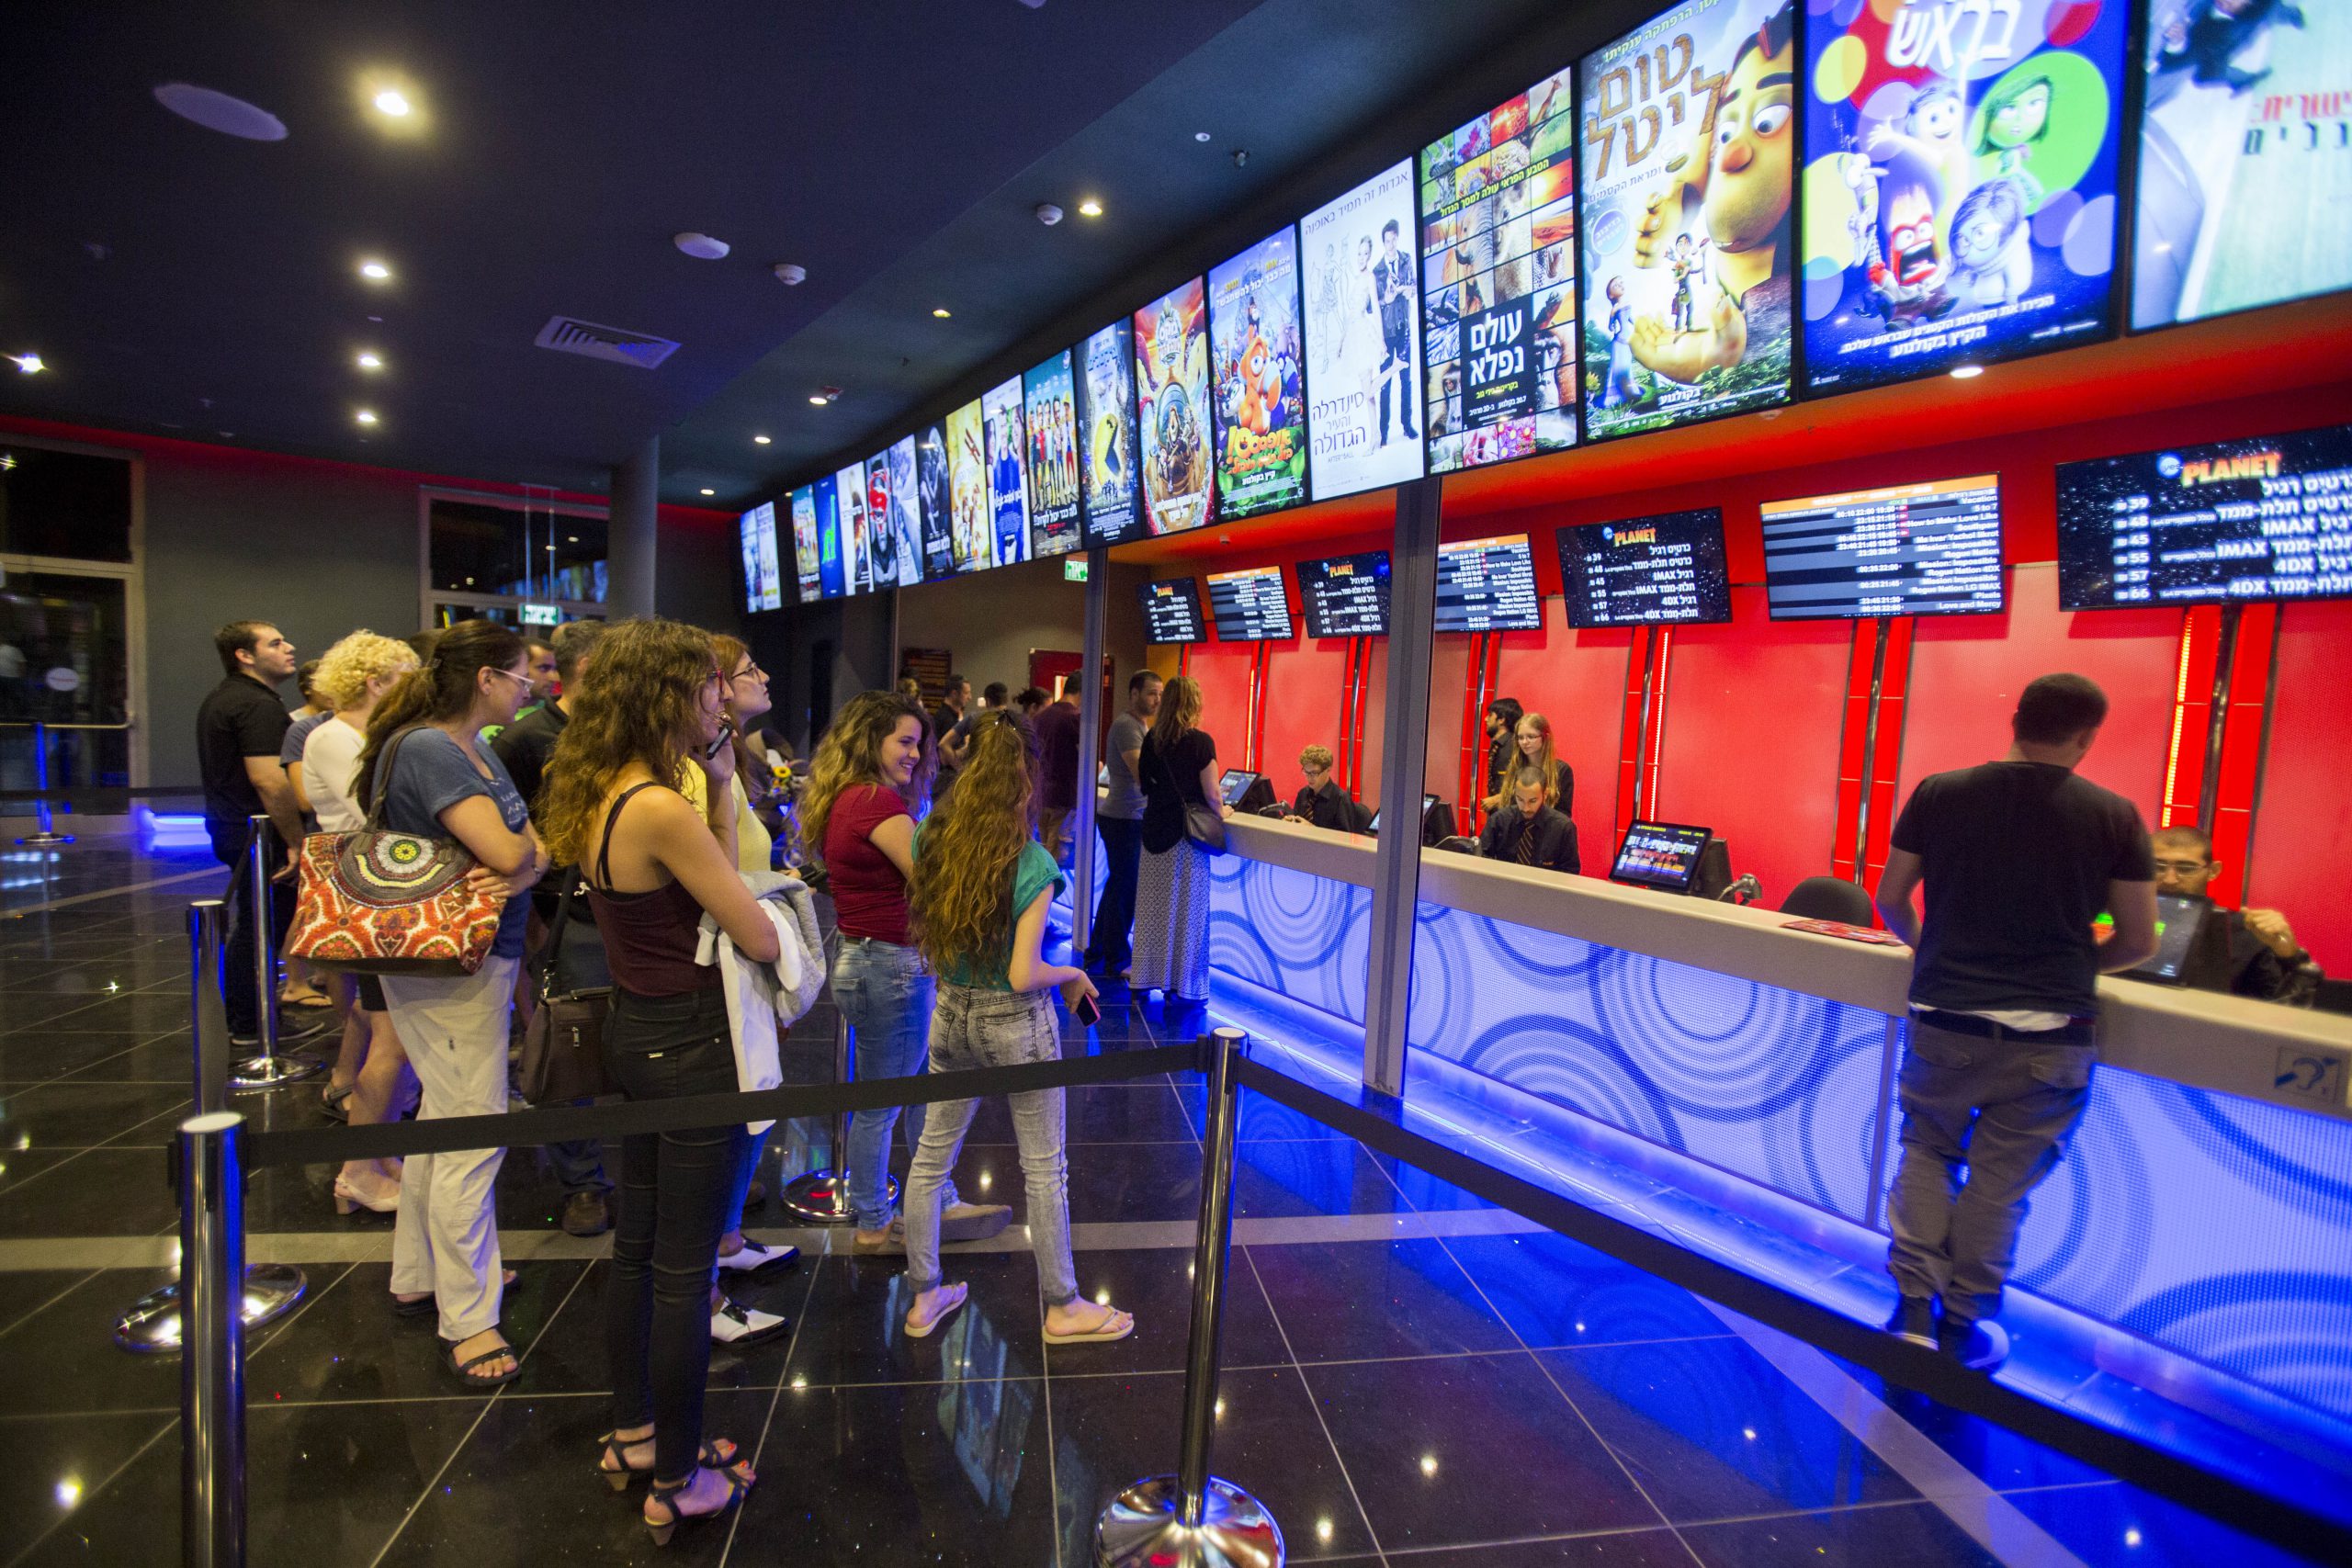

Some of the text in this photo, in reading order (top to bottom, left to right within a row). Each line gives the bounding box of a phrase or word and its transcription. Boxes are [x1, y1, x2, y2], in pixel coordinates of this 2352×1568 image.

[1645, 6, 1693, 40] הרפתקה
[1886, 0, 2021, 70] בראש
[1598, 33, 1694, 121] טום
[1587, 65, 1725, 181] ליטל
[1500, 171, 1525, 188] הפראי
[1589, 166, 1662, 203] ומראת הקסמים
[1481, 182, 1499, 199] עולה
[1305, 171, 1408, 236] אגדות זה תמיד באופנה
[1461, 191, 1480, 209] למסך
[1440, 200, 1460, 217] הגדול
[1265, 270, 1278, 283] כבר
[1279, 264, 1292, 276] מה
[1250, 278, 1264, 291] יכול
[1470, 309, 1522, 352] עולם
[1891, 325, 1987, 358] הקיץ בקולנוע
[1470, 345, 1525, 387] נפלא
[1659, 389, 1702, 406] בקולנוע
[1312, 391, 1364, 422] סינדרלה
[1326, 415, 1351, 431] והעיר
[1314, 426, 1366, 457] הגדולה
[2181, 453, 2281, 488] PLANET
[2260, 479, 2301, 498] רגיל
[1961, 495, 1997, 505] Vacation
[2128, 497, 2150, 510] 39
[2215, 497, 2301, 523] תלת-ממד
[1906, 519, 1925, 528] How
[1936, 515, 1957, 525] Make
[1959, 514, 1979, 523] Love
[1981, 513, 1998, 521] Like
[1956, 522, 1999, 532] Southpaw
[2128, 515, 2150, 528] 48
[2262, 517, 2316, 536] IMAX
[1613, 527, 1657, 547] PLANET
[1952, 539, 1997, 549] Impossible
[2128, 534, 2150, 547] 45
[1648, 545, 1667, 557] רגיל
[1944, 548, 2000, 559] Rogue Nation
[2217, 541, 2268, 558] IMAX
[1953, 557, 1998, 568] Impossible
[2128, 552, 2150, 565] 55
[2274, 557, 2315, 574] 4DX
[1652, 571, 1677, 581] IMAX
[1677, 570, 1694, 581] רגיל
[1928, 570, 1953, 578] Rogue
[1954, 567, 1982, 576] Nation
[1954, 574, 1998, 584] Impossible
[2128, 570, 2150, 582] 57
[1634, 585, 1658, 595] IMAX
[1911, 587, 1937, 595] Rogue
[1938, 584, 1964, 593] Nation
[1979, 582, 2001, 591] IMAX
[2128, 587, 2150, 601] 66
[2228, 579, 2267, 595] 4DX
[1660, 596, 1679, 606] 4DX
[1679, 595, 1697, 606] רגיל
[1960, 601, 1975, 609] and
[1976, 601, 2002, 610] Mercy
[1644, 610, 1660, 620] 4DX
